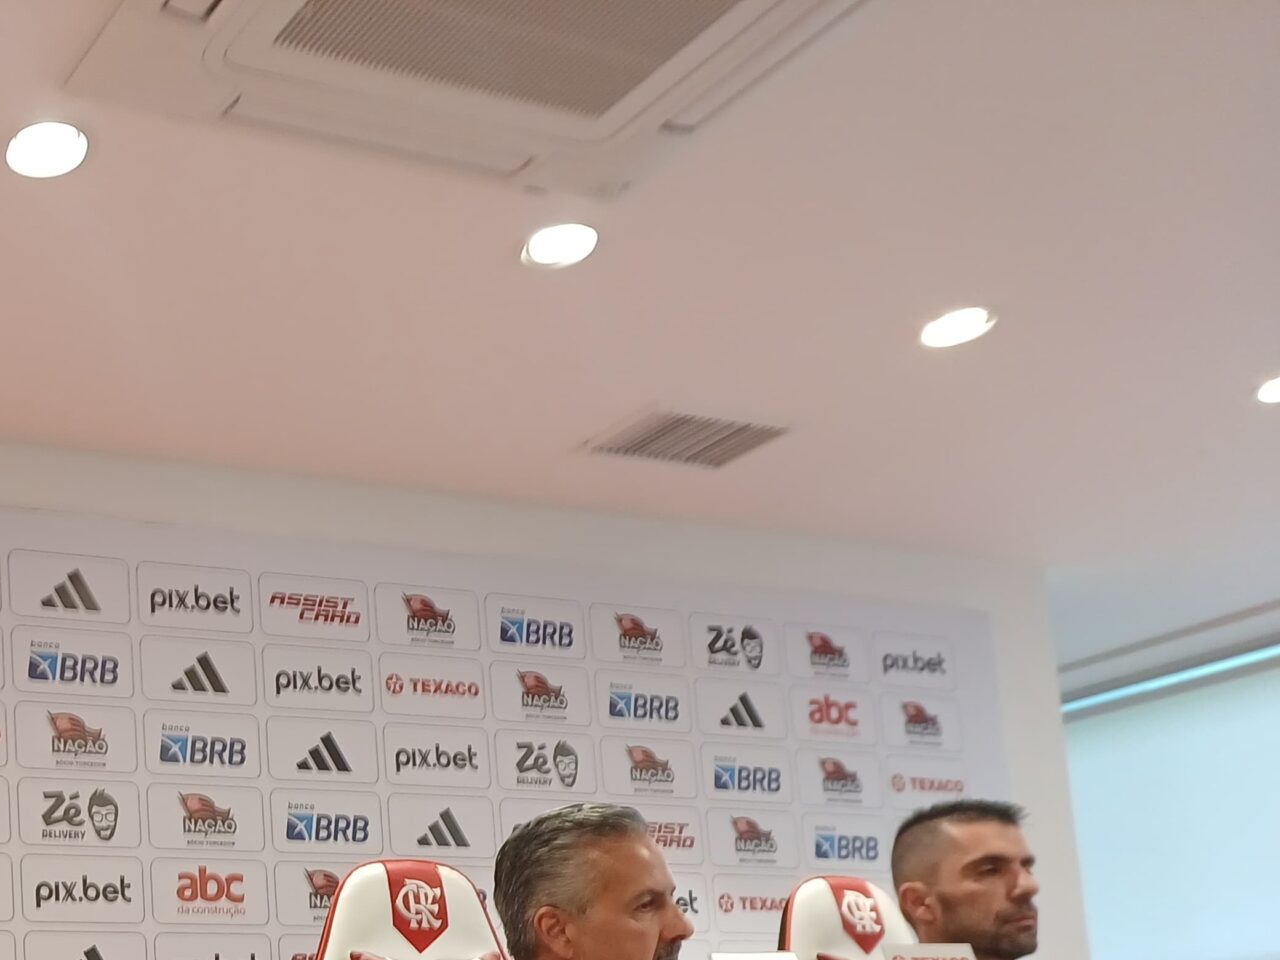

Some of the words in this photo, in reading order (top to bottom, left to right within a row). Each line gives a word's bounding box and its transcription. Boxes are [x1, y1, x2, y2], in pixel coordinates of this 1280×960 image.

[150, 584, 240, 615] pix.bet
[269, 591, 354, 610] ASSIST
[526, 620, 574, 648] BRB
[59, 654, 119, 686] BRB
[275, 667, 362, 695] pix.bet
[410, 677, 479, 696] TEXACO
[633, 695, 679, 722] BRB
[809, 695, 859, 726] abc
[189, 735, 246, 766] BRB
[396, 743, 479, 775] pix.bet
[516, 741, 550, 774] Zé
[737, 766, 781, 792] BRB
[42, 790, 85, 827] Zé
[42, 828, 86, 840] DELIVERY
[315, 814, 369, 843] BRB
[838, 836, 878, 860] BRB
[35, 874, 132, 907] pix.bet
[177, 866, 245, 902] abc
[739, 896, 787, 911] TEXAC
